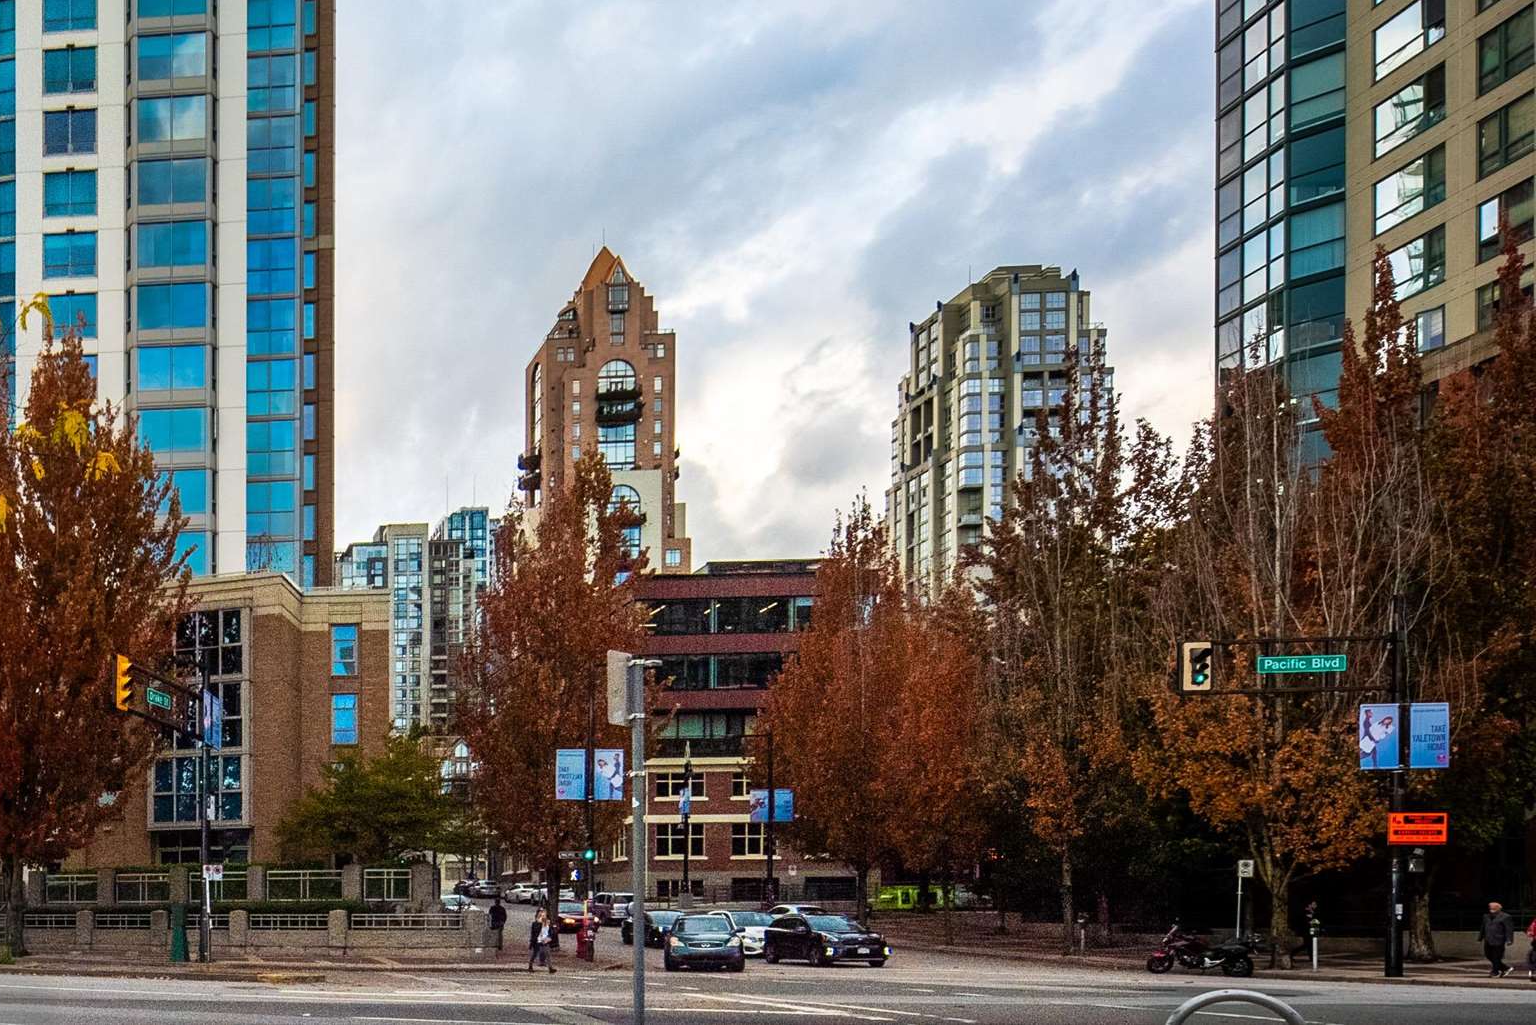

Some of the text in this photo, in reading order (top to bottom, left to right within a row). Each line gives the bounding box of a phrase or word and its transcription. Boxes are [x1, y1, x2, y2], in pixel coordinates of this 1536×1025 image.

[1264, 657, 1340, 670] Pacific Blvd
[1431, 724, 1446, 733] TAKE
[1412, 733, 1446, 743] YALETOWN
[1426, 742, 1446, 751] HOME
